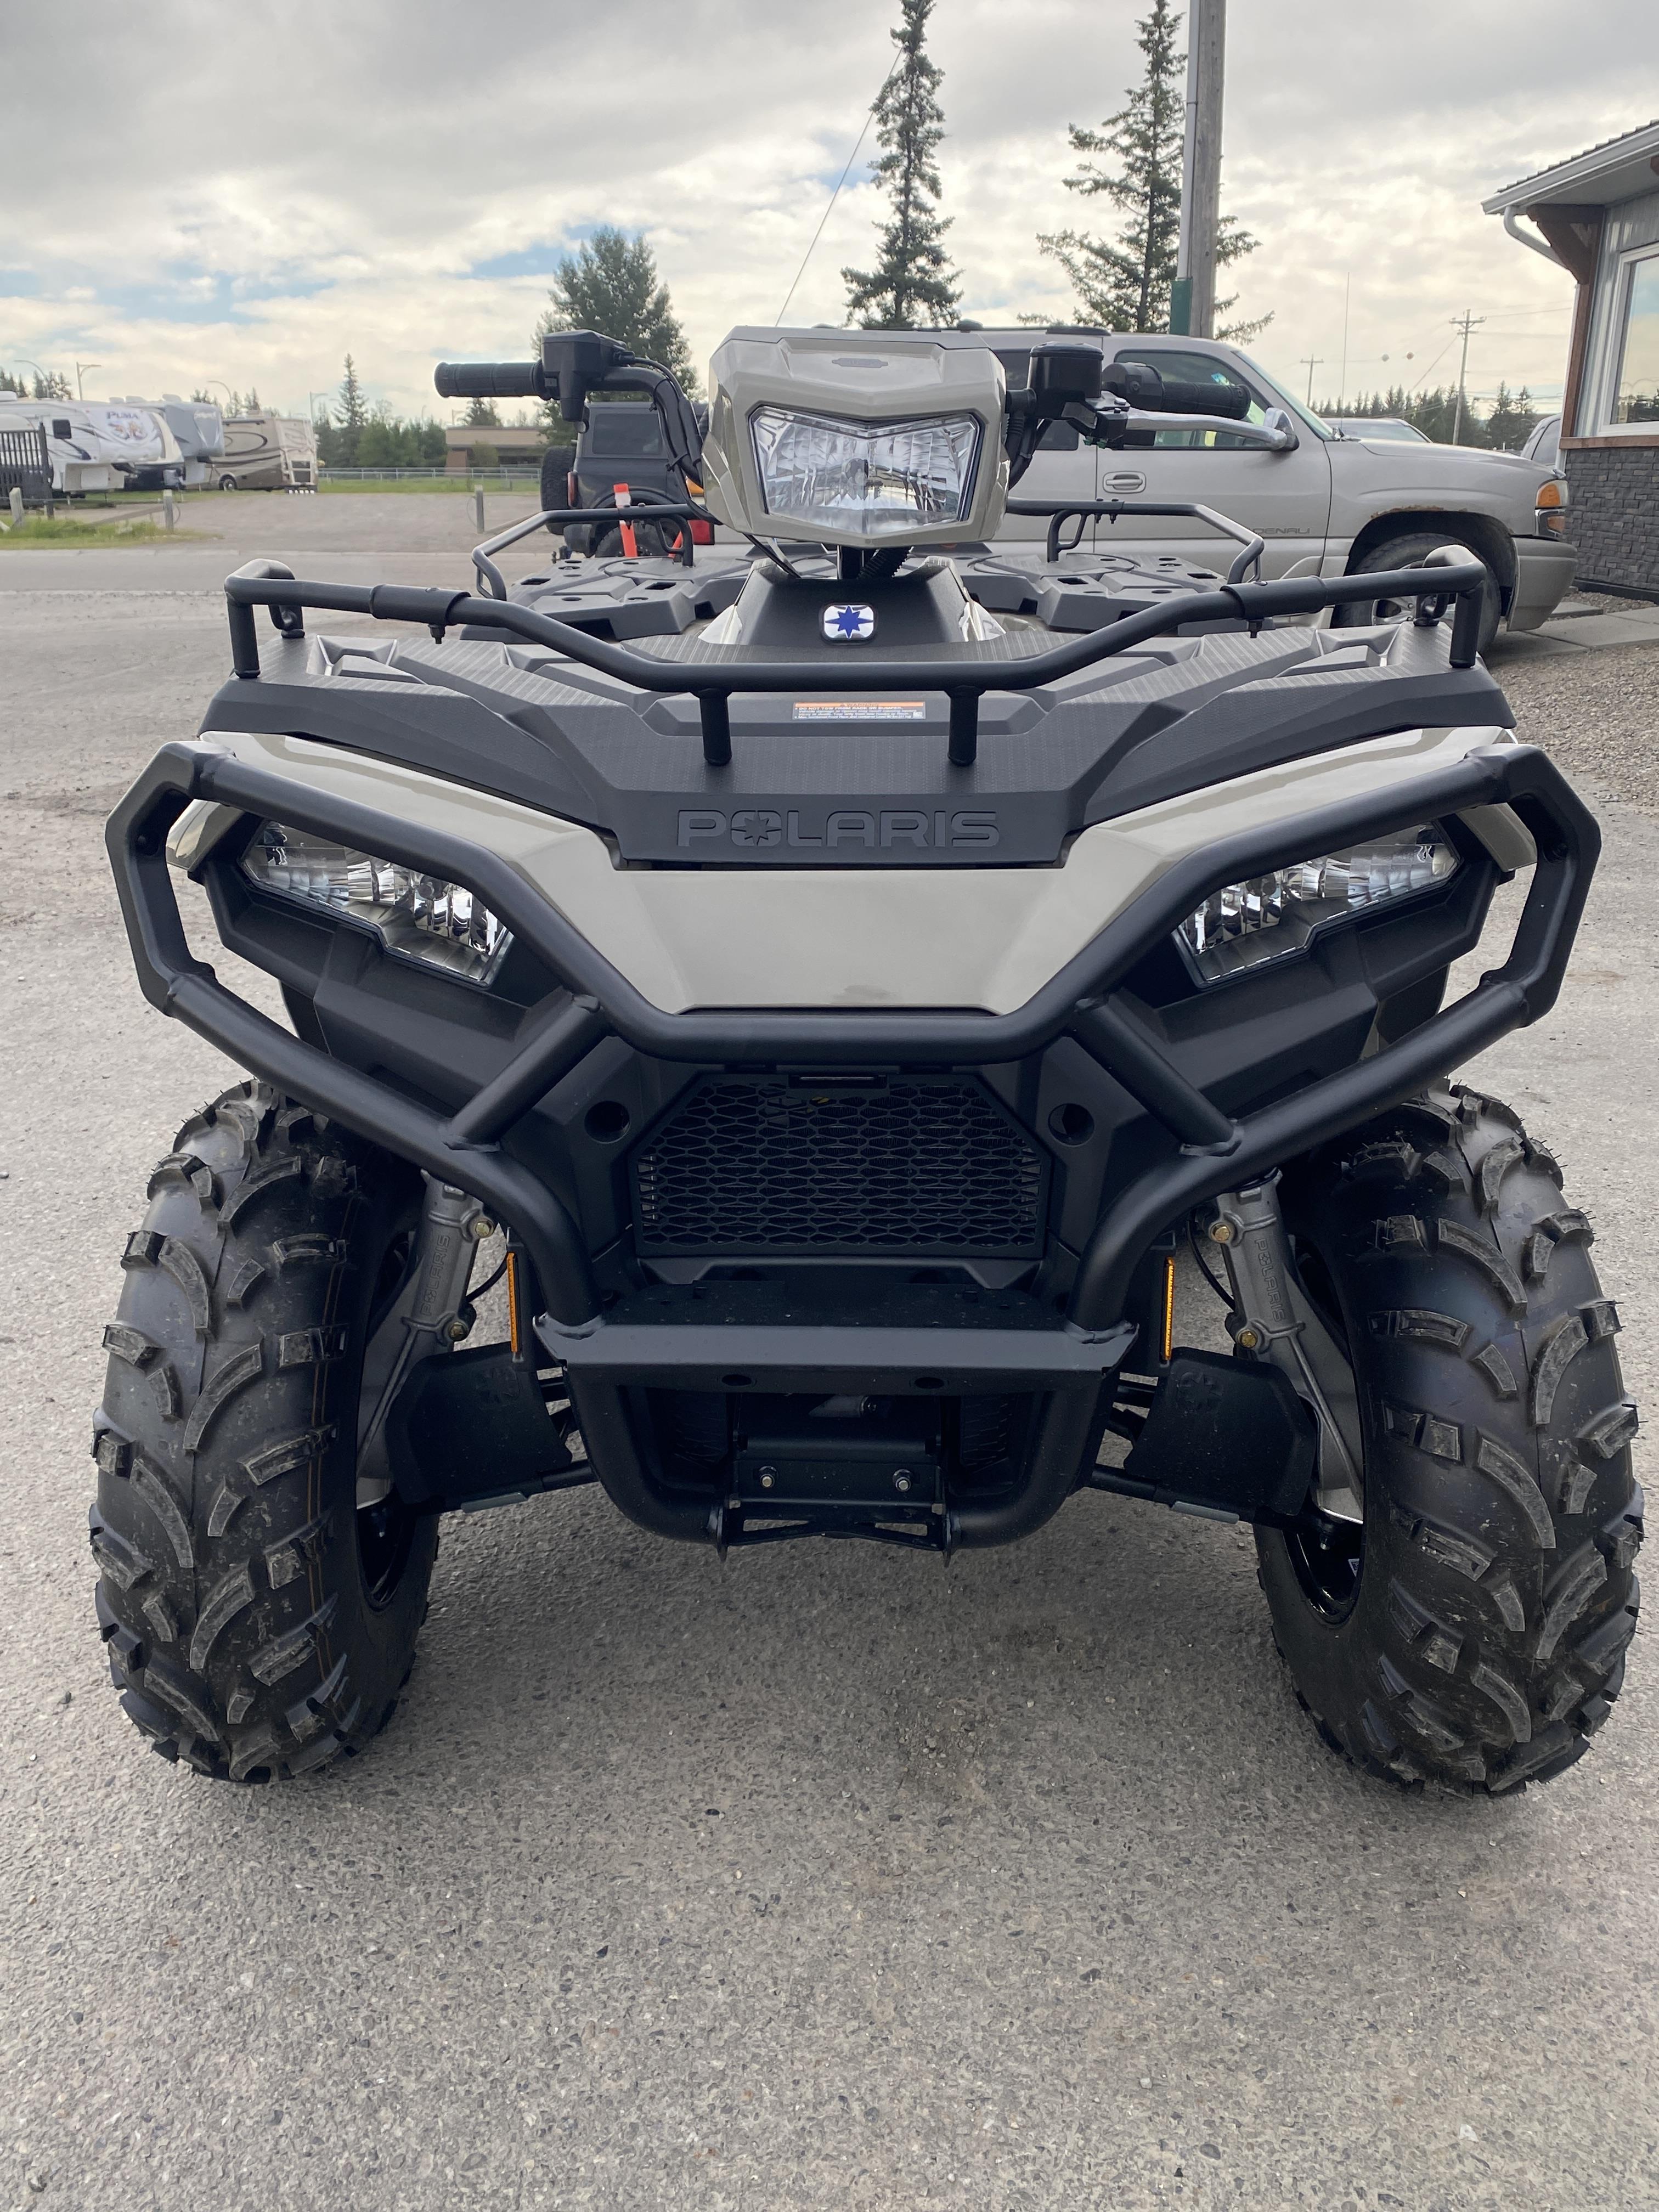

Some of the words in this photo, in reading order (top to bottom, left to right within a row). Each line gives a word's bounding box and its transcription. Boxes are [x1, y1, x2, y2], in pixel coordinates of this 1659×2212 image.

[678, 810, 999, 847] POLARIS
[421, 1235, 450, 1316] POLARIS
[1254, 1238, 1285, 1322] POLARIS
